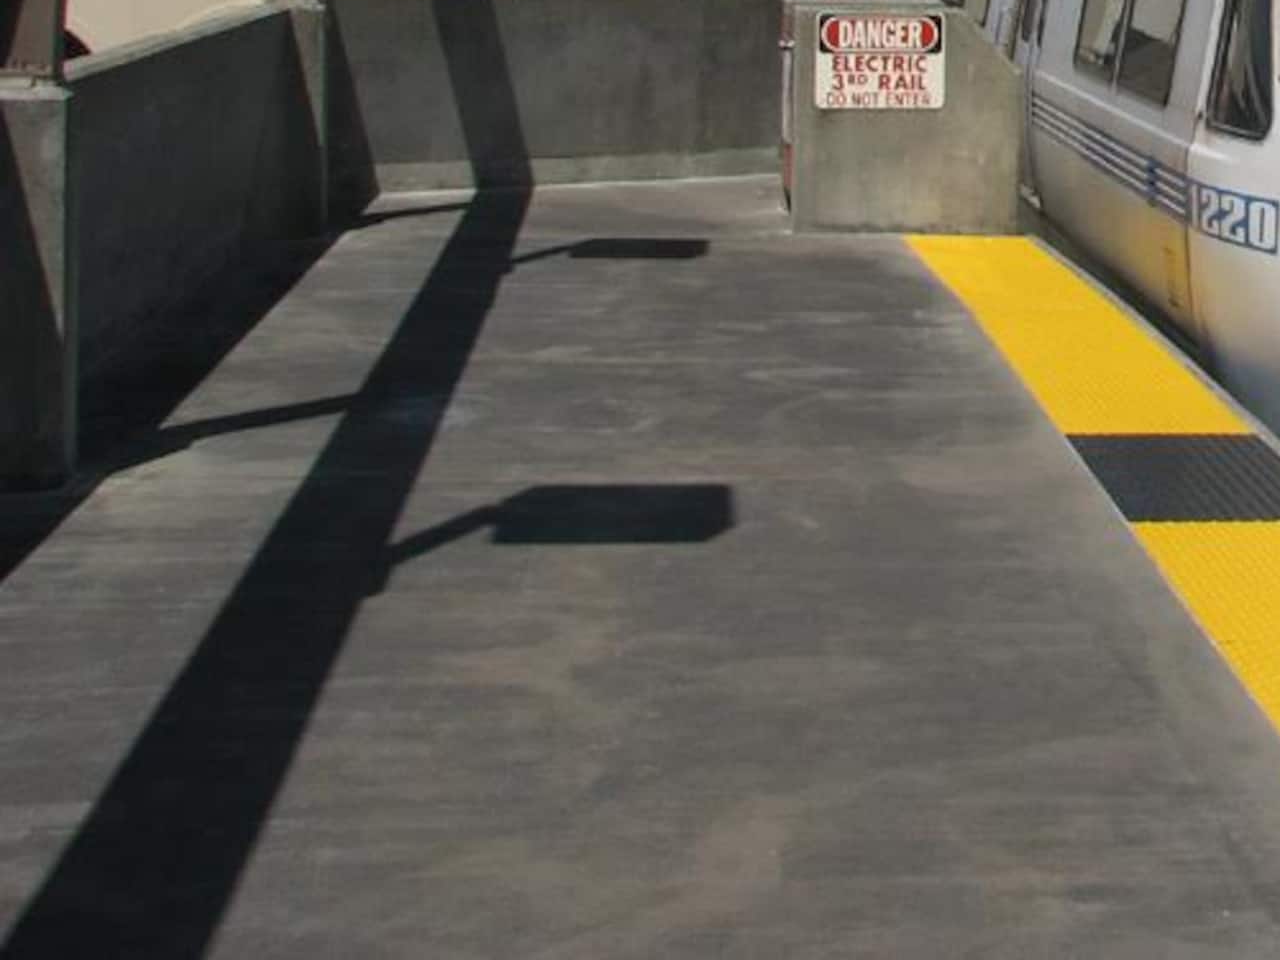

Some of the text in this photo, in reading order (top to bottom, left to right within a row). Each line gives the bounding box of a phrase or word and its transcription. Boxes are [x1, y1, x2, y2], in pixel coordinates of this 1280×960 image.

[838, 19, 922, 49] DANGER
[832, 55, 927, 72] ELECTRIC
[832, 74, 926, 90] 3RD RAIL
[826, 92, 931, 106] DO NOT ENTER
[1191, 183, 1279, 252] 1220
